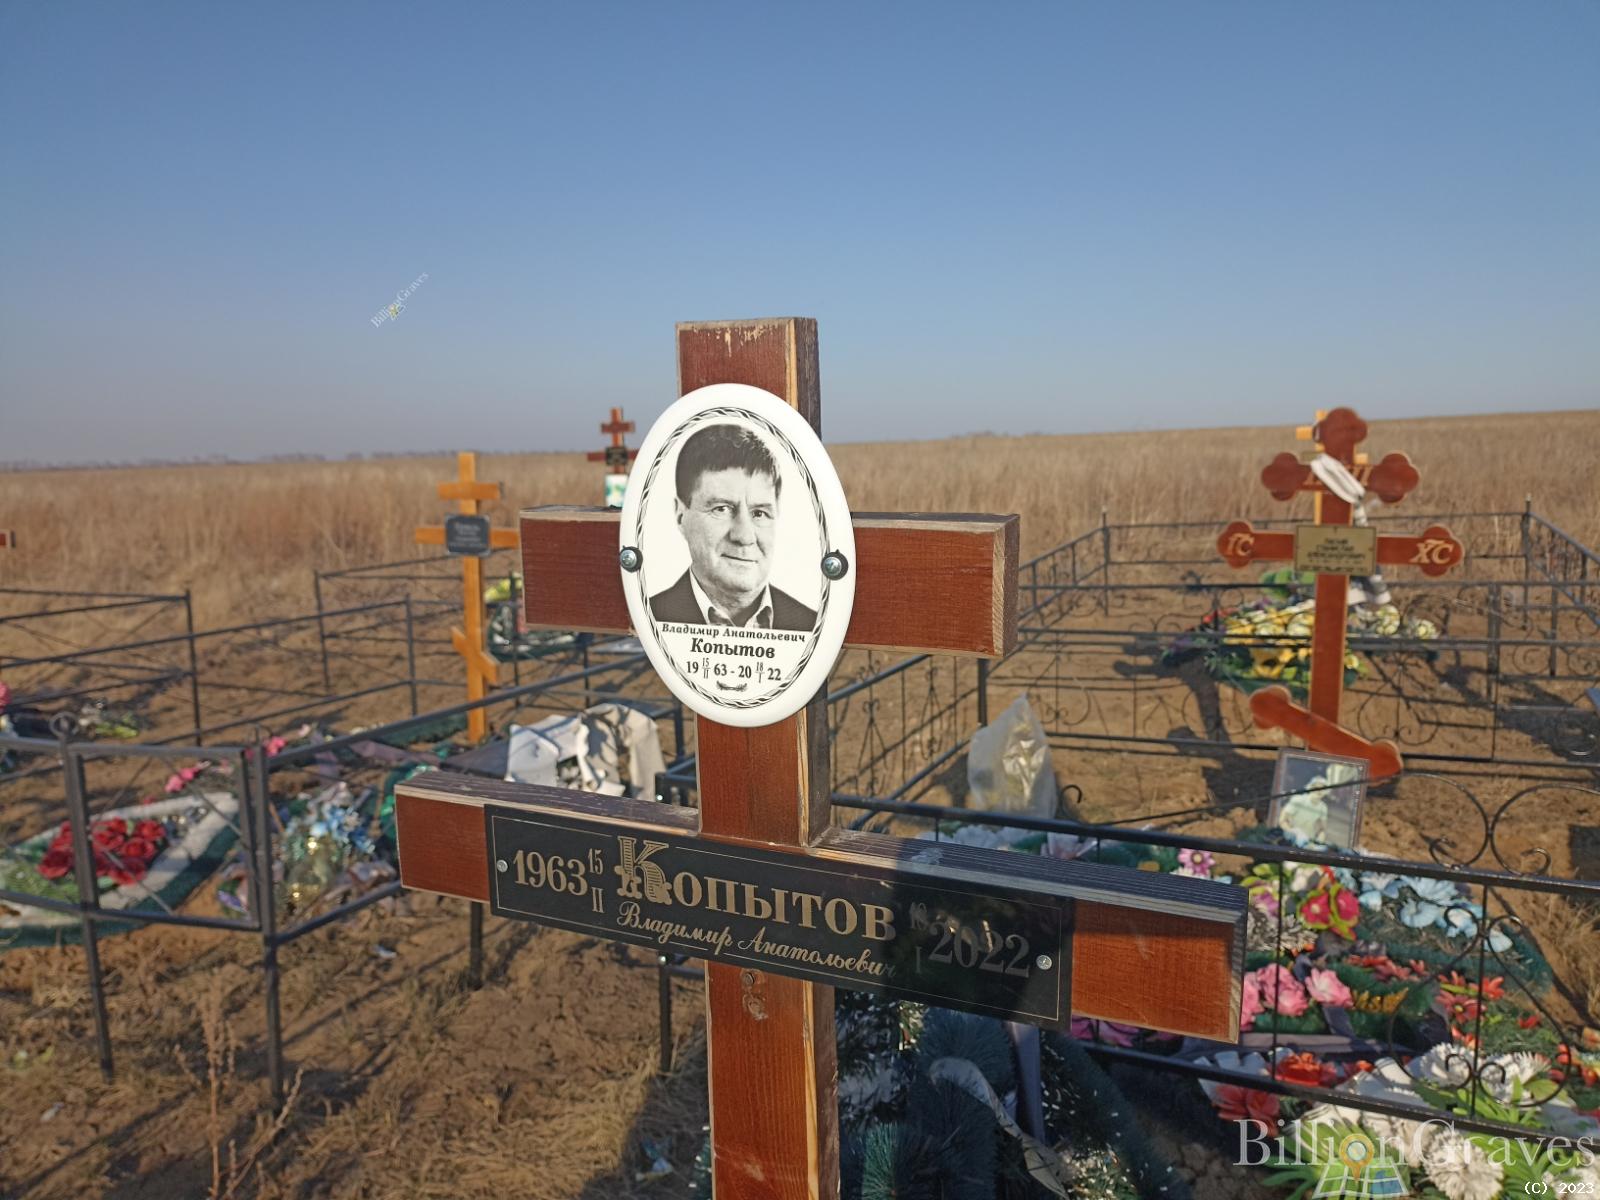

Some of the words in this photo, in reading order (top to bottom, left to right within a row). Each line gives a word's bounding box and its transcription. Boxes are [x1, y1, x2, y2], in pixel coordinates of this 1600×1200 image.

[662, 623, 720, 637] Владимир
[723, 625, 806, 642] Анатольевич
[690, 637, 775, 658] Копытов
[686, 661, 699, 674] 19
[702, 657, 709, 667] 15
[713, 663, 727, 676] 63
[738, 665, 752, 678] 20
[767, 668, 782, 681] 22
[513, 850, 588, 897] 1963
[588, 848, 603, 875] 15
[928, 921, 1030, 978] 2022
[616, 901, 733, 955] Владимир
[737, 926, 896, 978] Анатольевич
